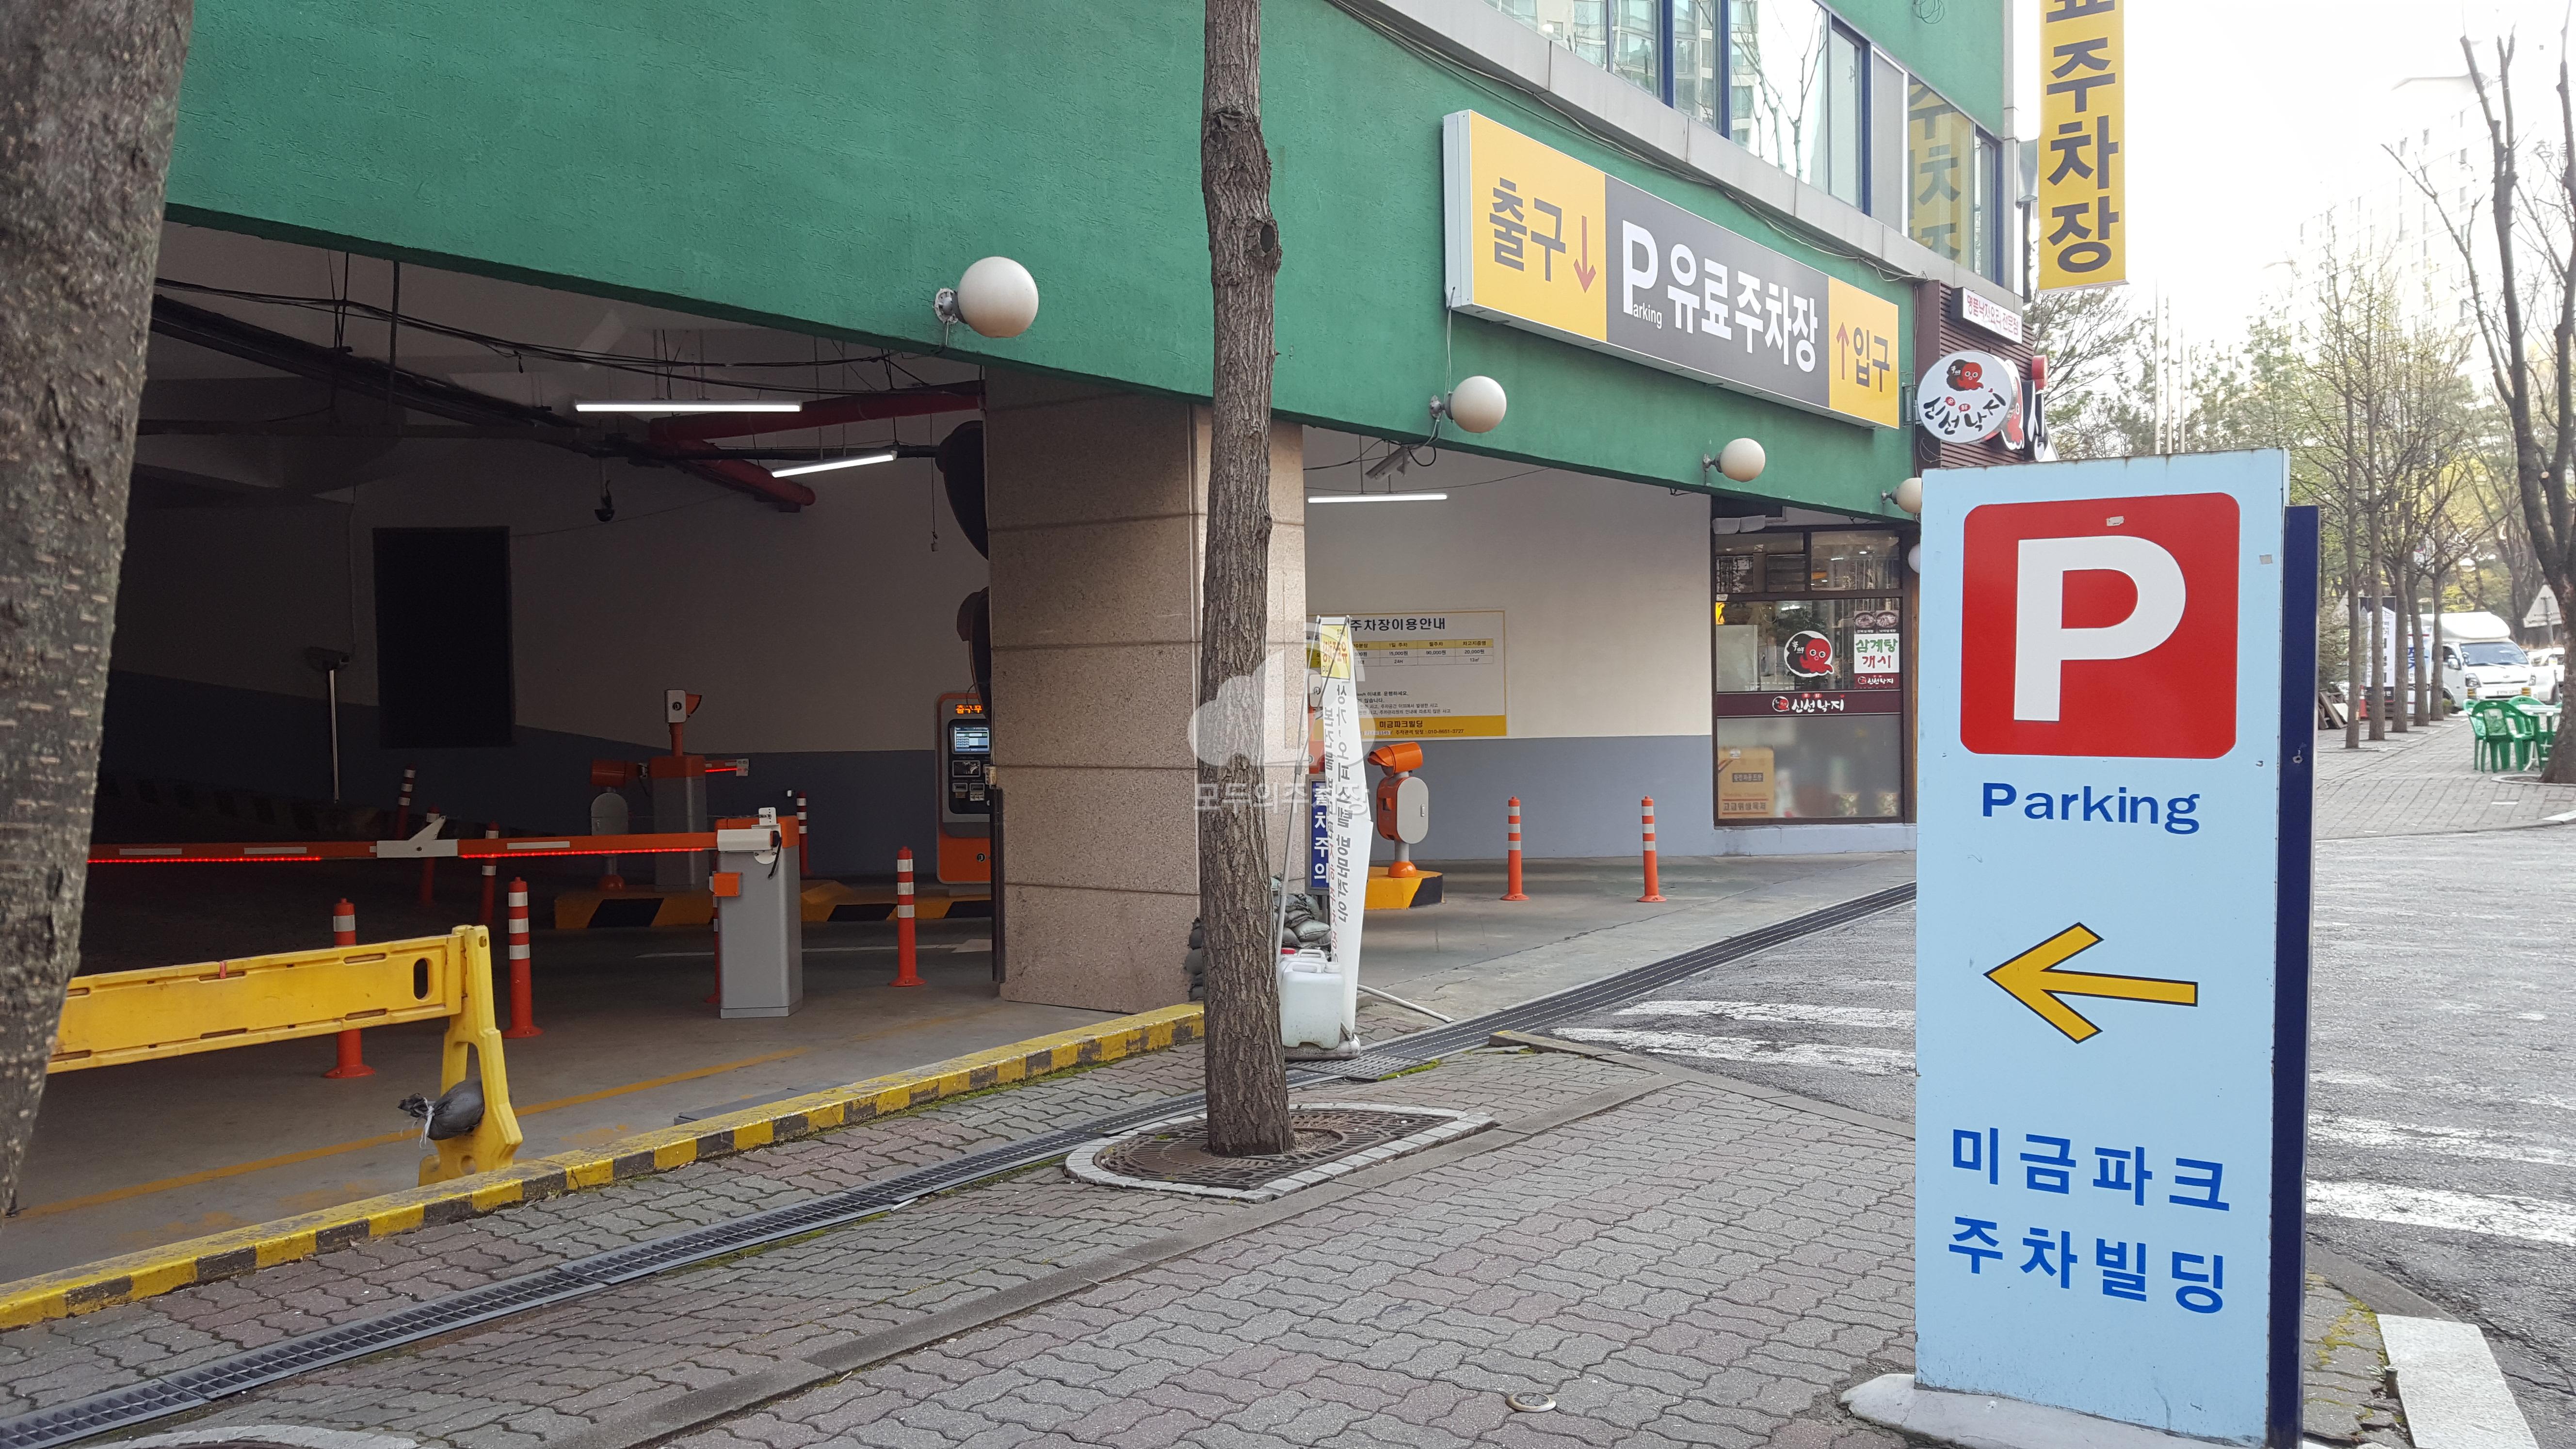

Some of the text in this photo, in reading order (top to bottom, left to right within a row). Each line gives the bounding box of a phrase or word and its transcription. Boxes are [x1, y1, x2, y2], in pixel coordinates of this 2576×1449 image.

[1489, 177, 1566, 282] 출구
[1667, 243, 1818, 373] 유료주차장
[1967, 294, 2019, 335] 명품낙지요리 전문점
[1853, 327, 1890, 393] 입구
[1923, 392, 2006, 435] 신선낙지
[1350, 618, 1446, 631] 주차장이용안내
[1855, 638, 1898, 653] 삼계탕
[2013, 535, 2187, 722] P
[1862, 655, 1891, 669] 개시
[1791, 698, 1844, 713] 신선낙지
[1982, 782, 2201, 835] Parking
[1952, 1127, 2230, 1211] 미금파크
[1948, 1216, 2223, 1314] 주차빌딩
